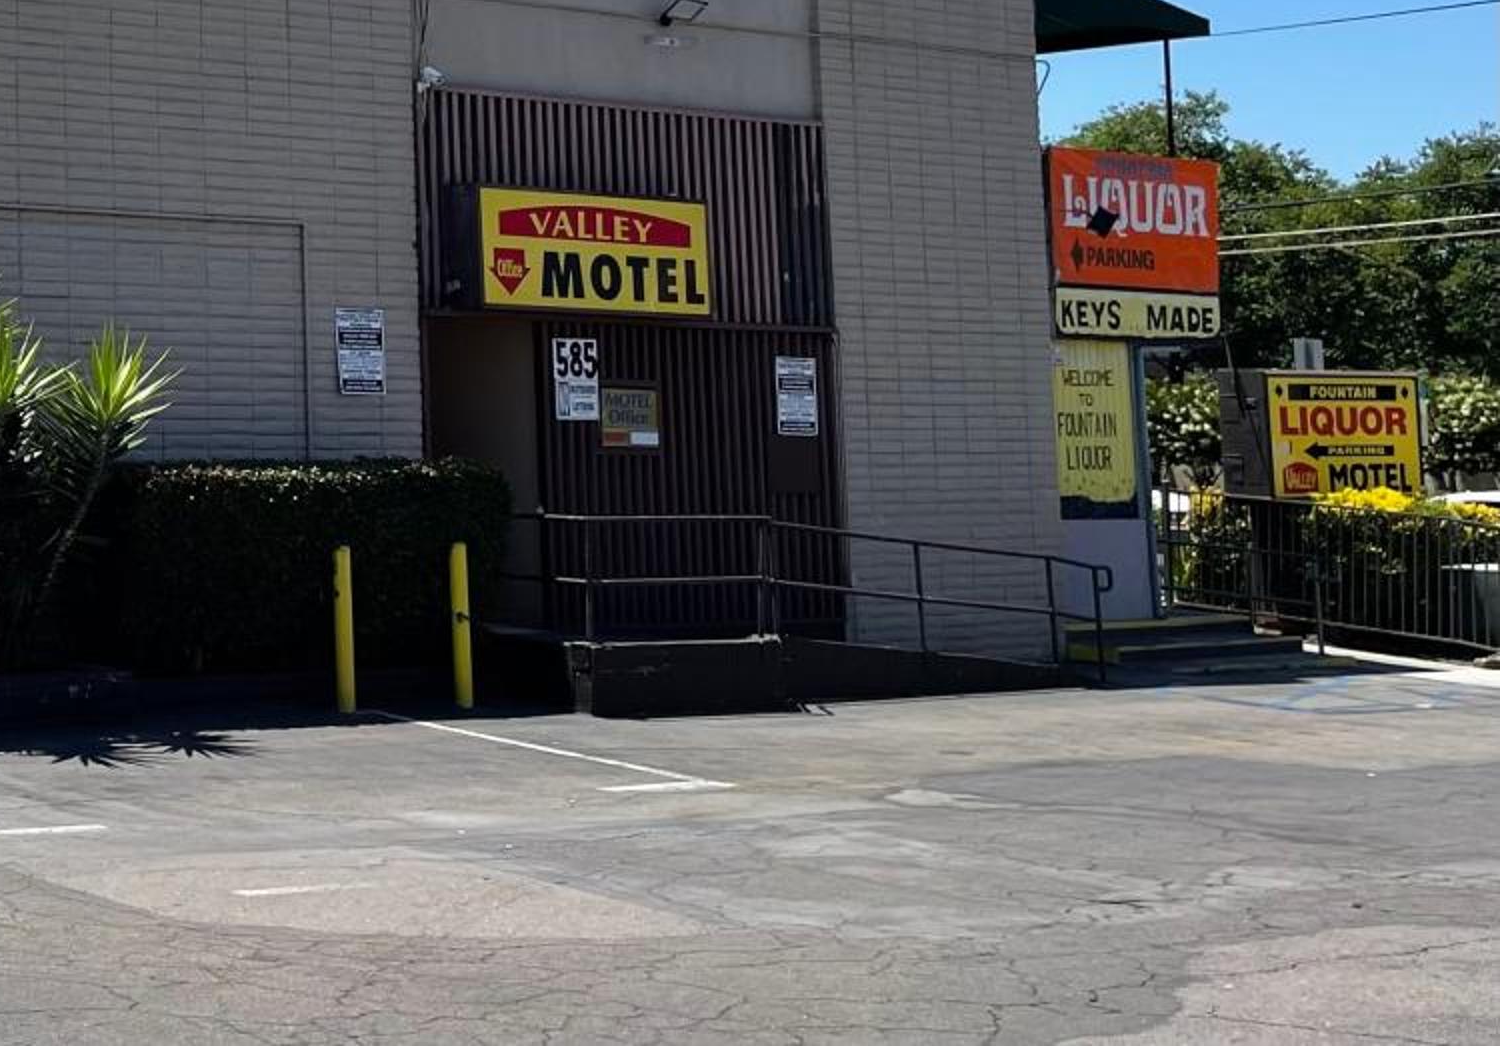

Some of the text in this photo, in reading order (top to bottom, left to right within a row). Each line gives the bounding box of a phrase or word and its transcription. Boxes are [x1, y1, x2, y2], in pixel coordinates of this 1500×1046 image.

[1062, 173, 1209, 237] LIQUOR
[529, 210, 652, 243] VALLEY
[1086, 246, 1155, 269] PARKING
[541, 250, 705, 305] MOTEL
[1061, 299, 1214, 334] KEYS MADE
[556, 341, 598, 379] 585
[1061, 368, 1116, 387] WELCOME
[1309, 385, 1377, 399] FOUNTAIN
[1079, 393, 1094, 407] TO
[1057, 411, 1117, 438] FOUNTAIN
[1279, 405, 1407, 436] LIQUOR
[1065, 445, 1113, 471] LIQUOR
[1328, 462, 1413, 494] MOTEL
